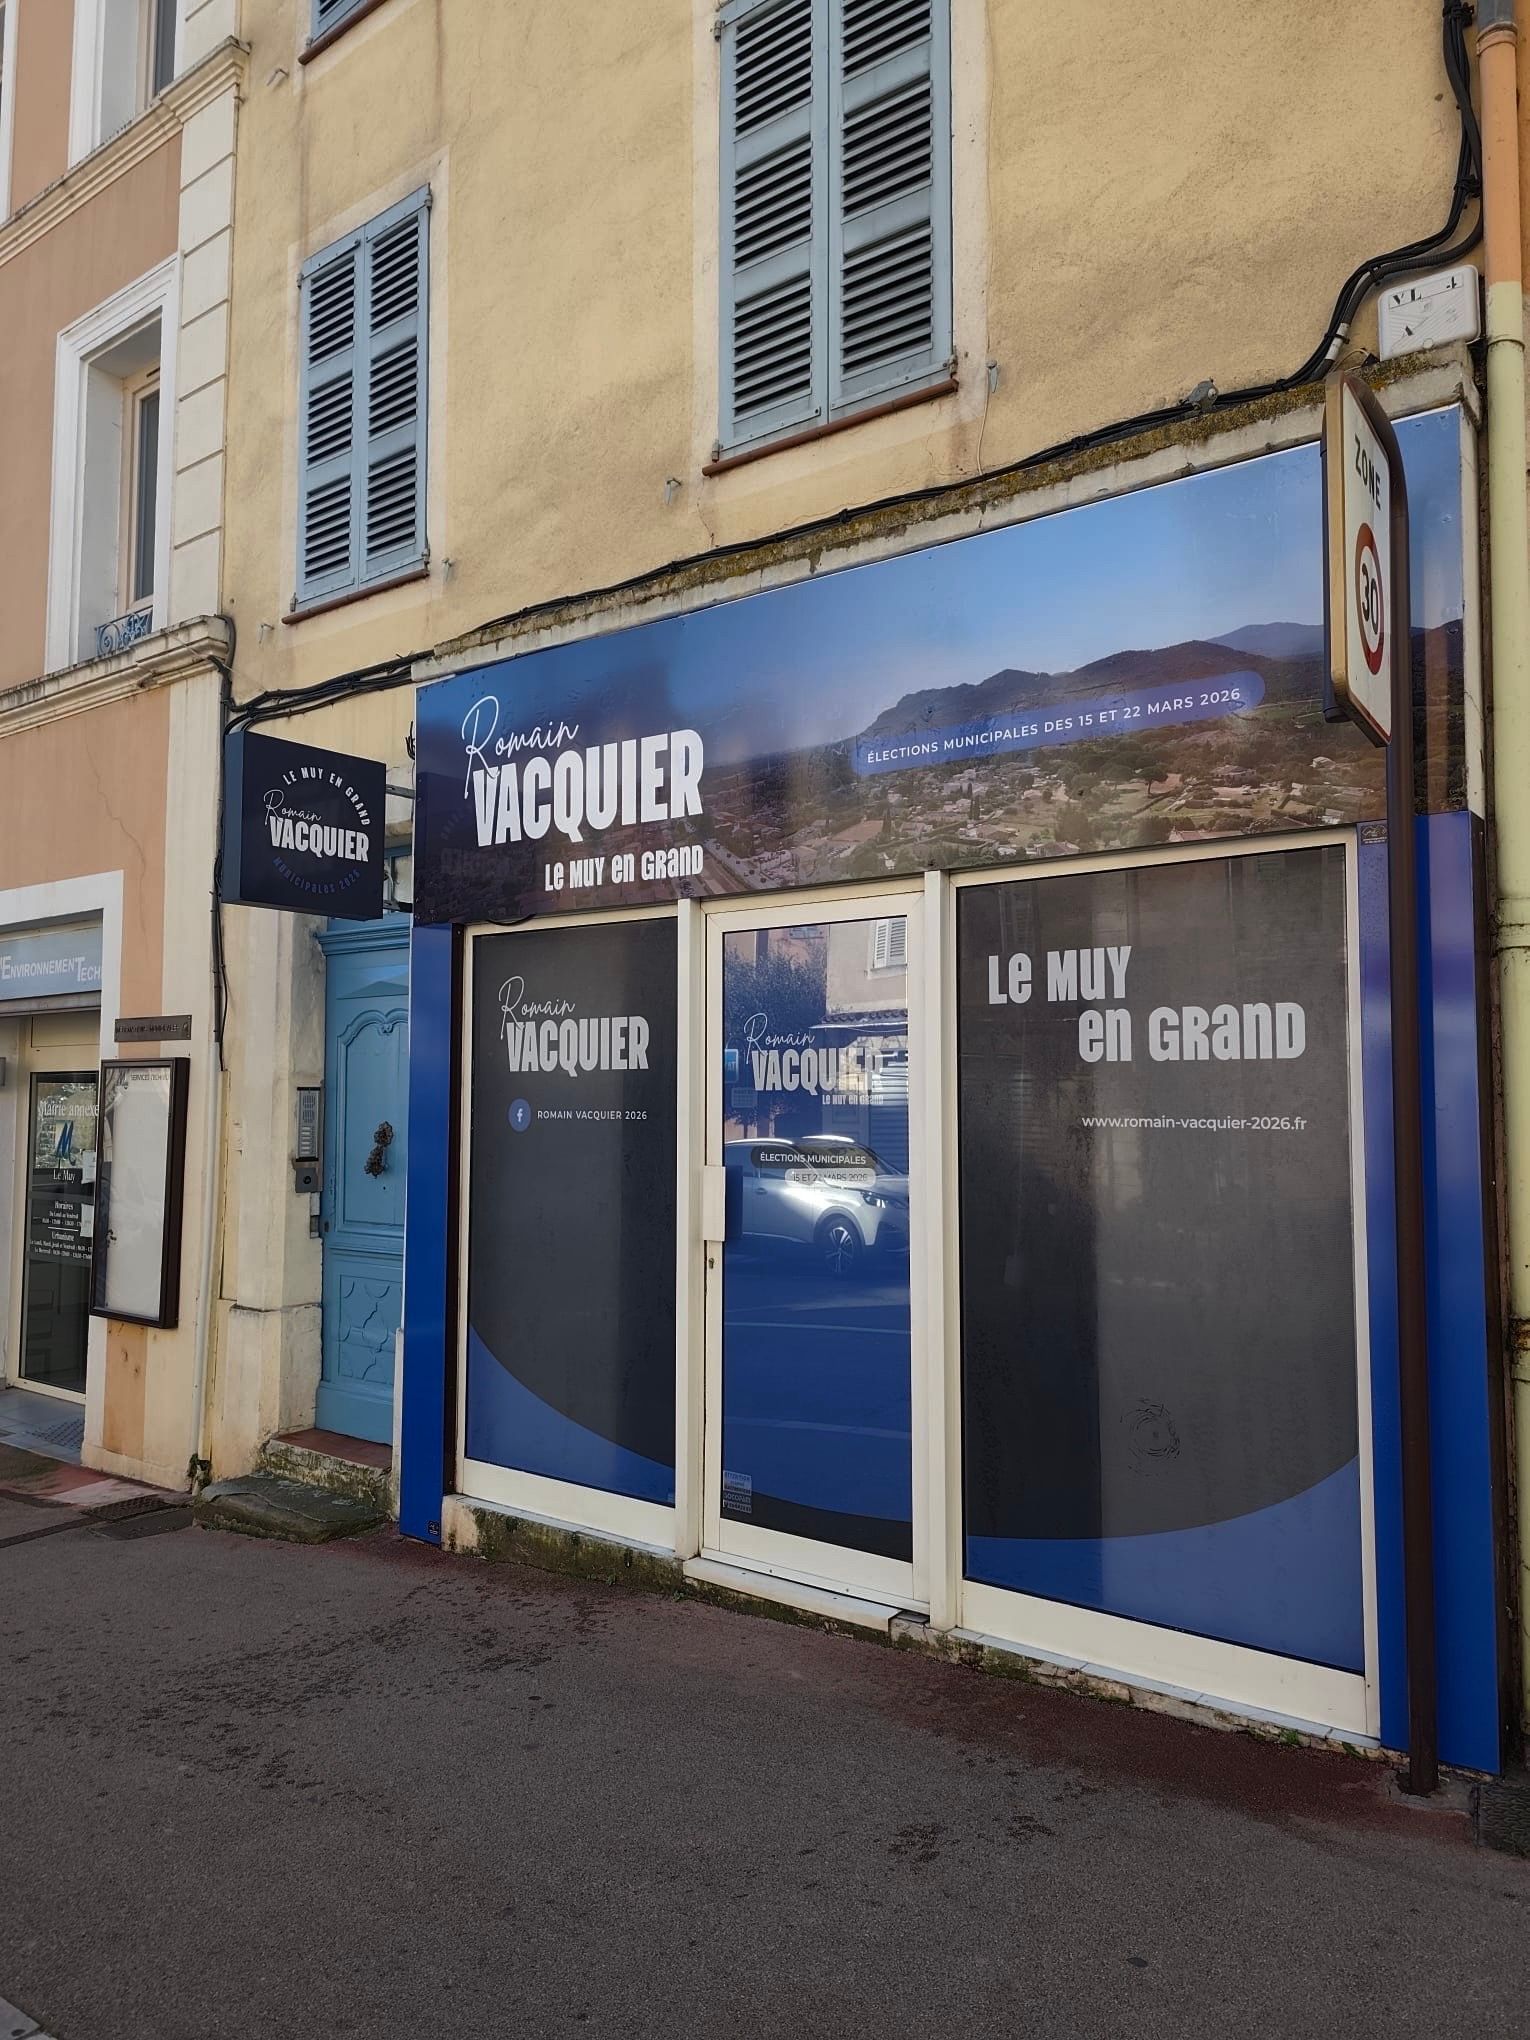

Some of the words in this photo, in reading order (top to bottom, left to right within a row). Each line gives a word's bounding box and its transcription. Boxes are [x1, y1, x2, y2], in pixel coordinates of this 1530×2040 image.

[1354, 432, 1382, 512] ZONE
[1361, 561, 1379, 636] 30
[461, 695, 580, 800] Romain
[866, 740, 940, 765] ÉLECTIONS
[943, 724, 1039, 751] MUNICIPALES
[1044, 716, 1074, 734] DES
[1078, 713, 1094, 728] 15
[1098, 709, 1118, 724] ET
[1122, 706, 1142, 720] 22
[1146, 696, 1195, 717] MARS
[1199, 687, 1242, 706] 2026
[263, 789, 322, 826] Romain
[283, 770, 298, 785] LE
[300, 767, 324, 780] MUY
[329, 773, 344, 788] EN
[345, 786, 371, 826] GRAND
[472, 729, 704, 847] VACQUIER
[269, 815, 370, 863] VACQUIER
[498, 975, 576, 1041] Romain
[506, 1015, 650, 1078] VACQUIER
[743, 1012, 816, 1065] Romain
[70, 1104, 99, 1116] annexe
[537, 1111, 573, 1120] ROMAIN
[576, 1111, 622, 1121] VACQUIER
[625, 1111, 648, 1120] 2026
[1081, 1115, 1307, 1132] www.romain-vacquier-2026.fr
[53, 1169, 61, 1180] Le
[63, 1169, 76, 1184] Muy
[760, 1151, 806, 1162] ÉLECTIONS
[807, 1155, 867, 1165] MUNICIPALES
